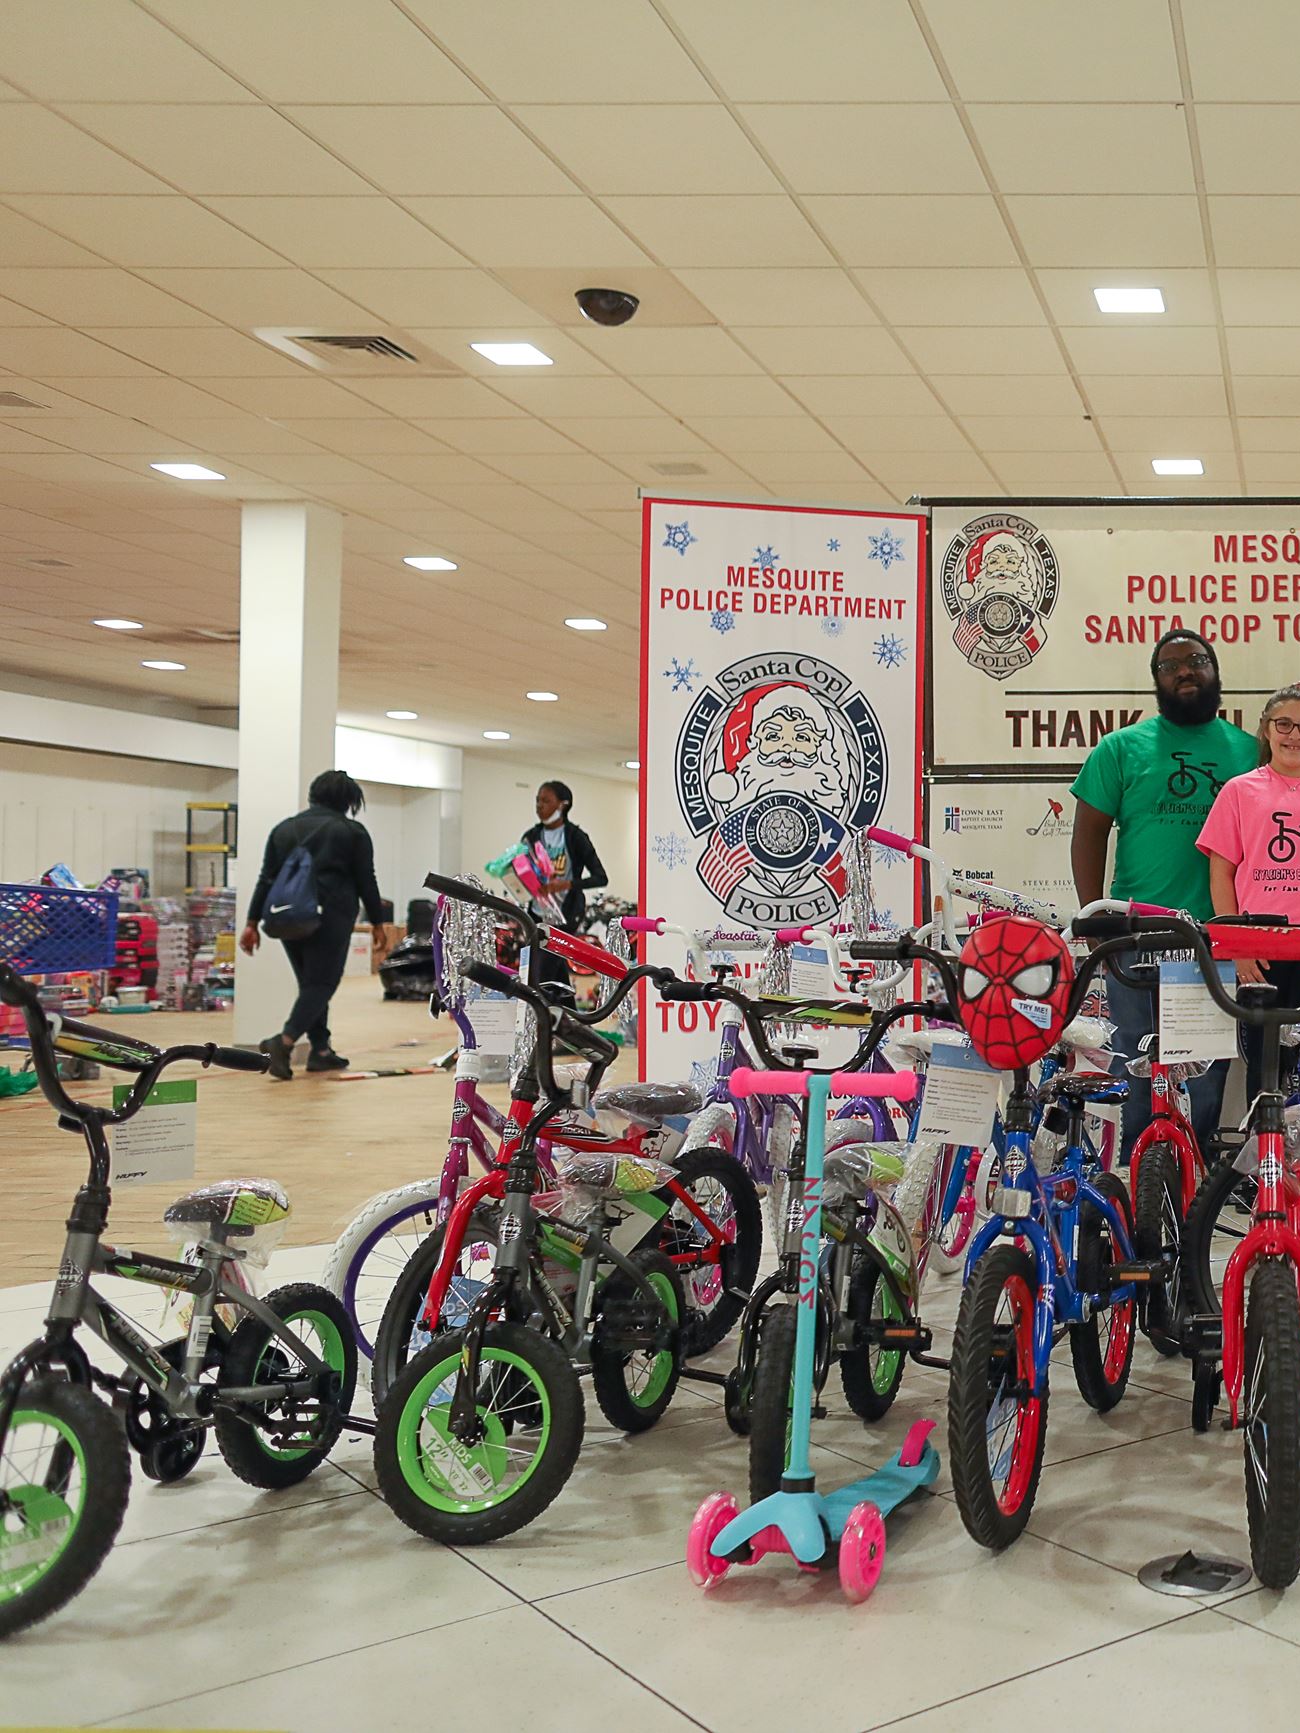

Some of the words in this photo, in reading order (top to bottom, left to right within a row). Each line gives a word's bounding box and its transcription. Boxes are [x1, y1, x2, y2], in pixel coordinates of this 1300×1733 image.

[965, 519, 1004, 538] Santa
[1006, 516, 1033, 538] Cop
[727, 566, 844, 592] MESQUITE
[945, 545, 962, 609] MESQUITE
[1040, 547, 1054, 598] TEXAS
[660, 588, 743, 613] POLICE
[753, 593, 906, 620] DEPARTMENT
[1126, 574, 1238, 604] POLICE
[1084, 614, 1184, 644] SANTA
[1200, 614, 1261, 643] COP
[974, 652, 1028, 668] POLICE
[722, 660, 790, 691] Santa
[795, 658, 843, 694] Cop
[684, 703, 716, 819] MESQUITE
[856, 713, 881, 804] TEXAS
[746, 825, 756, 847] THE
[751, 796, 782, 819] STATE
[788, 797, 804, 809] OF
[804, 808, 817, 848] TEXAS
[966, 870, 993, 879] Bobcat
[736, 896, 831, 922] POLICE
[655, 1002, 722, 1033] TOY
[1019, 1002, 1032, 1011] TRY
[1034, 1005, 1048, 1014] ME!
[1163, 1049, 1193, 1057] HUFFY
[921, 1126, 951, 1136] HUFFY
[116, 1170, 148, 1181] HUFFY
